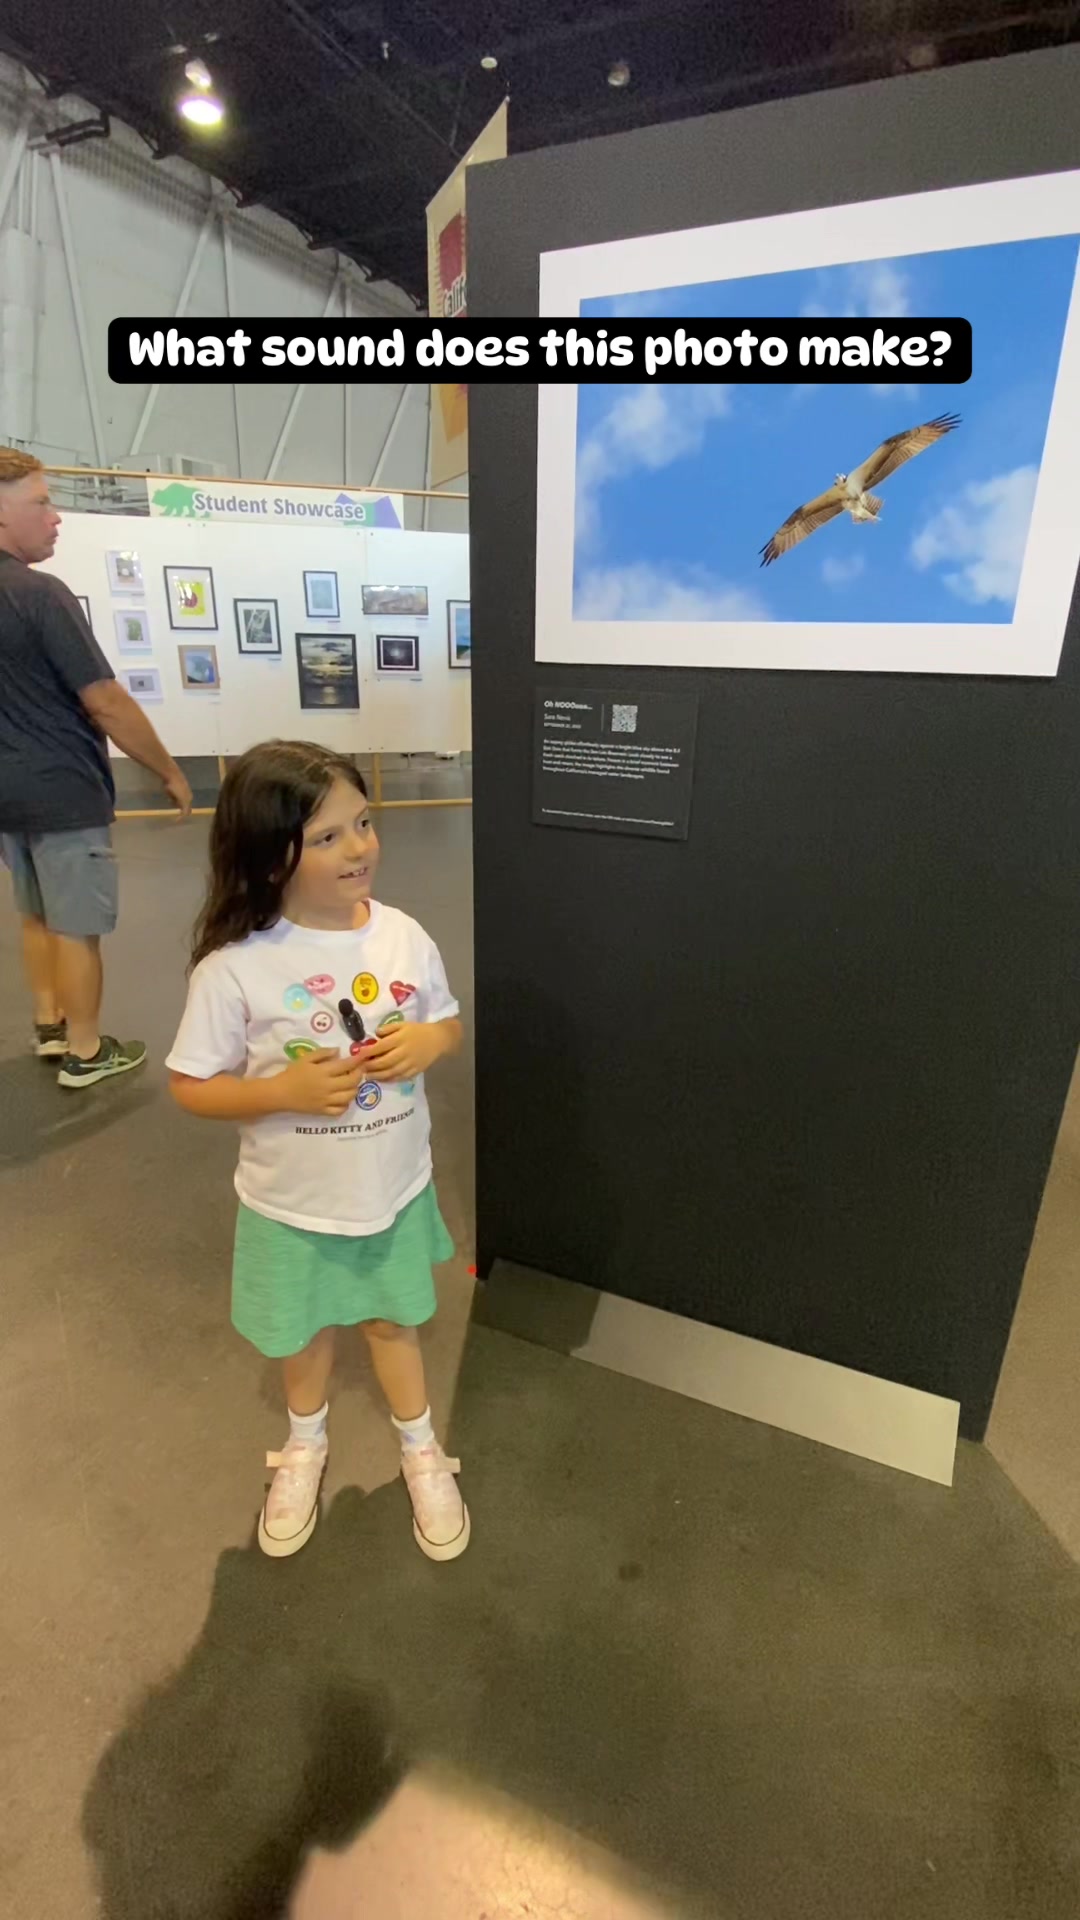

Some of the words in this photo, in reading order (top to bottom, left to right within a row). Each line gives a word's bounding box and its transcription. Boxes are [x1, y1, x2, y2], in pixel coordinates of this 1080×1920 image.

[194, 492, 268, 514] Student
[273, 498, 365, 520] Showcase
[295, 1126, 328, 1135] HELLO
[330, 1124, 362, 1134] KITTY
[365, 1120, 384, 1131] AND
